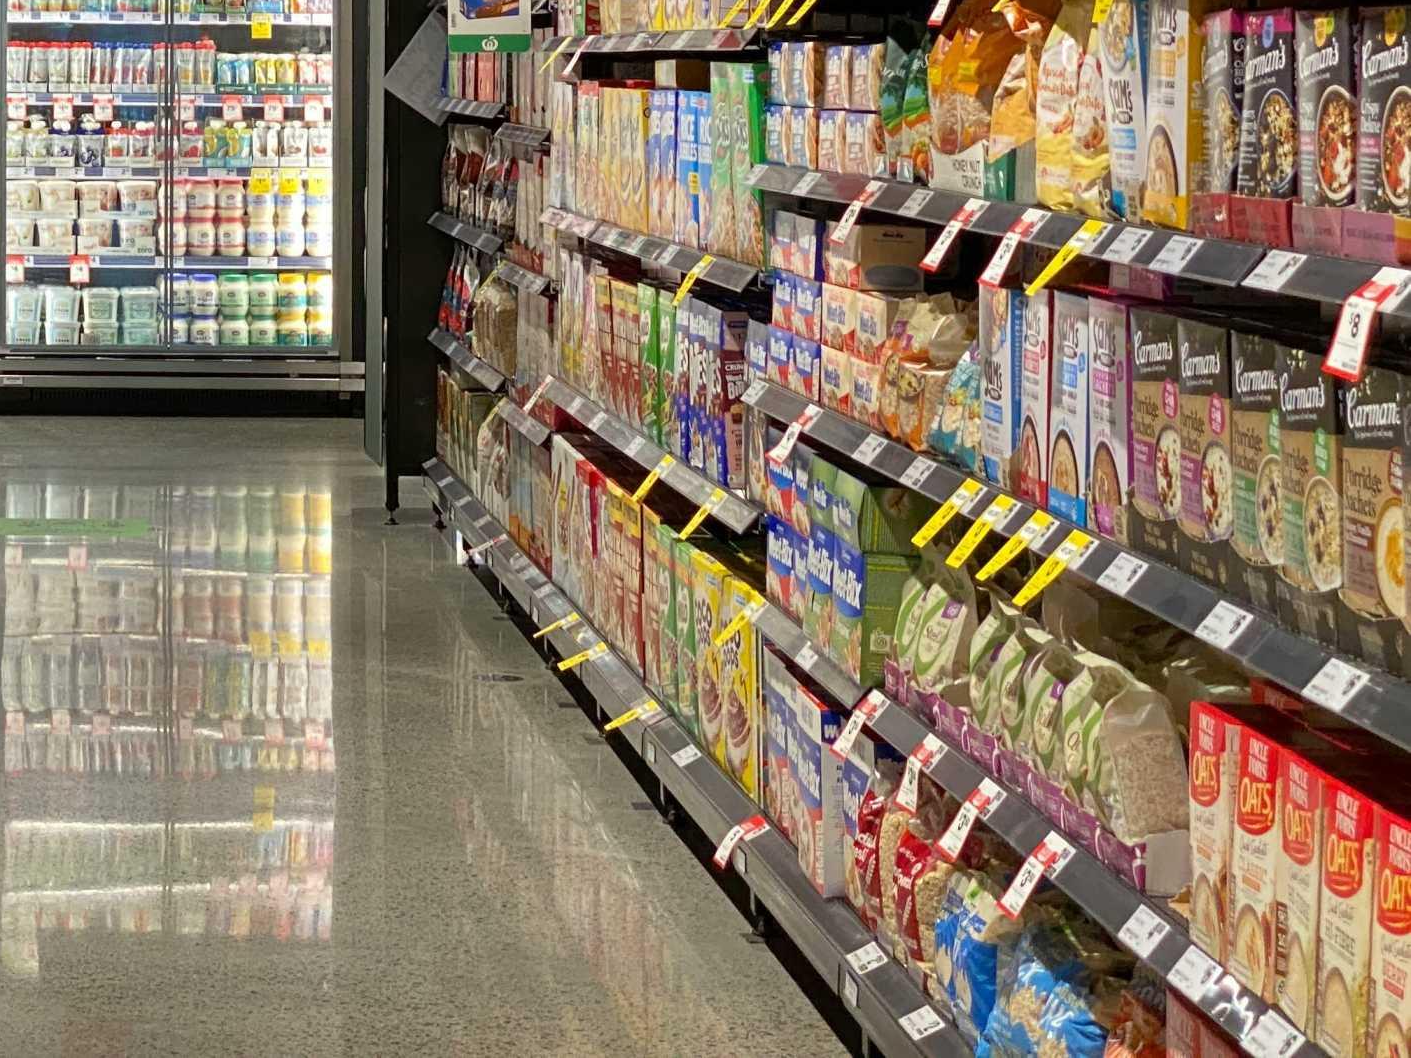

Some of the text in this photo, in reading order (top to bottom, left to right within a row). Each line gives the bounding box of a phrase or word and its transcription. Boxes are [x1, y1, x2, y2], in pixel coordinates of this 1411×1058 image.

[1192, 750, 1217, 787] OATS
[1239, 776, 1273, 816] OATS
[1284, 801, 1314, 844] OATS
[1327, 832, 1359, 878] OATS
